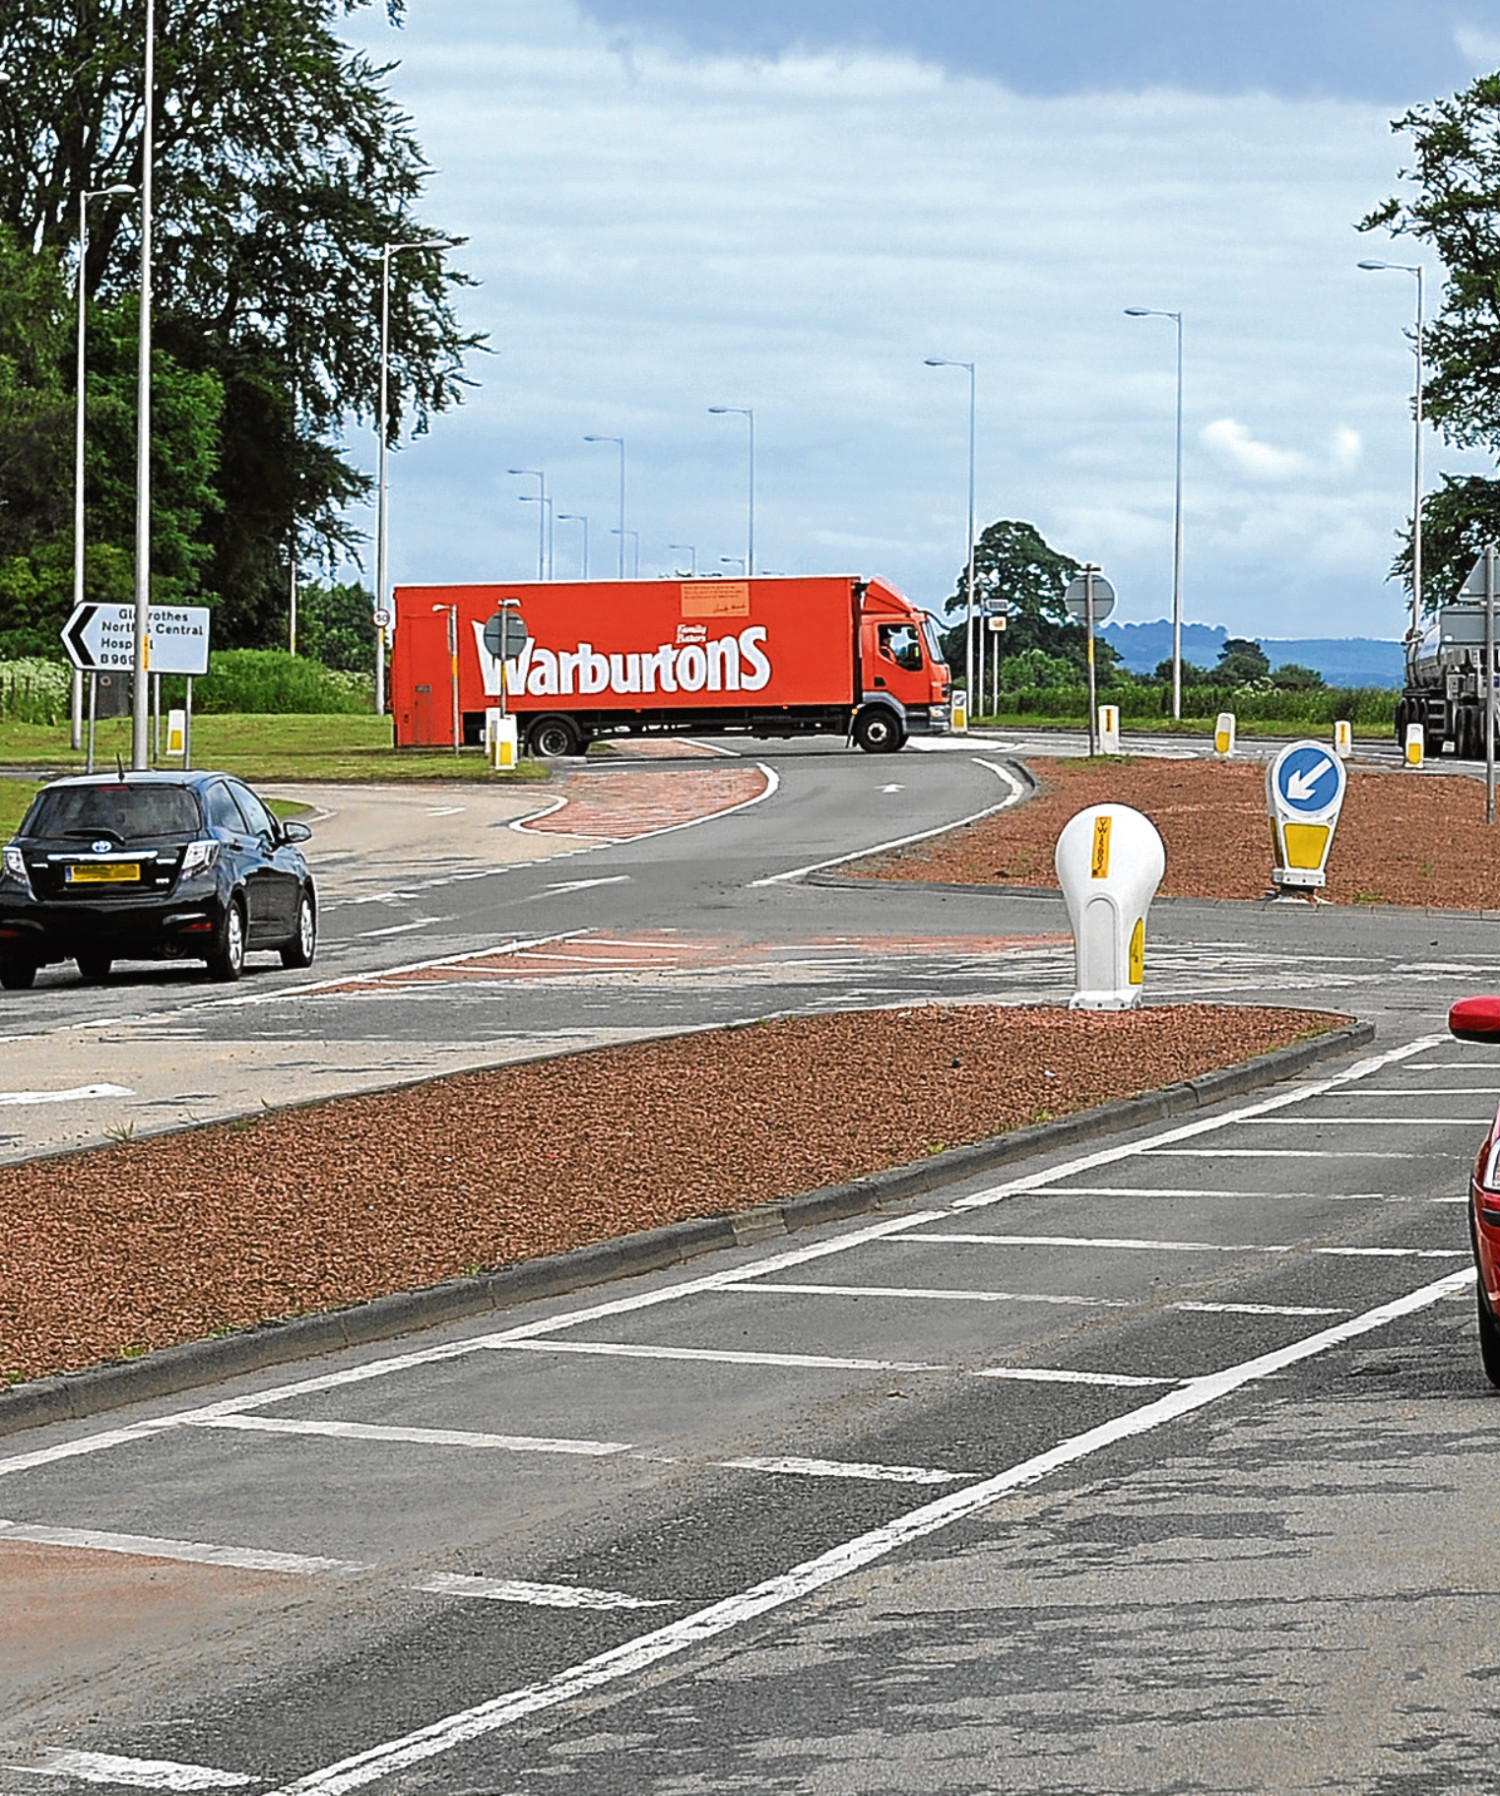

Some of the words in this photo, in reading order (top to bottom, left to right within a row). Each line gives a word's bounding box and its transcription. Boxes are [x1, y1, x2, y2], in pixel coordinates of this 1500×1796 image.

[118, 608, 188, 622] Glrothes
[155, 623, 203, 636] Central
[100, 637, 154, 650] Hospl
[471, 620, 772, 696] Warburtons
